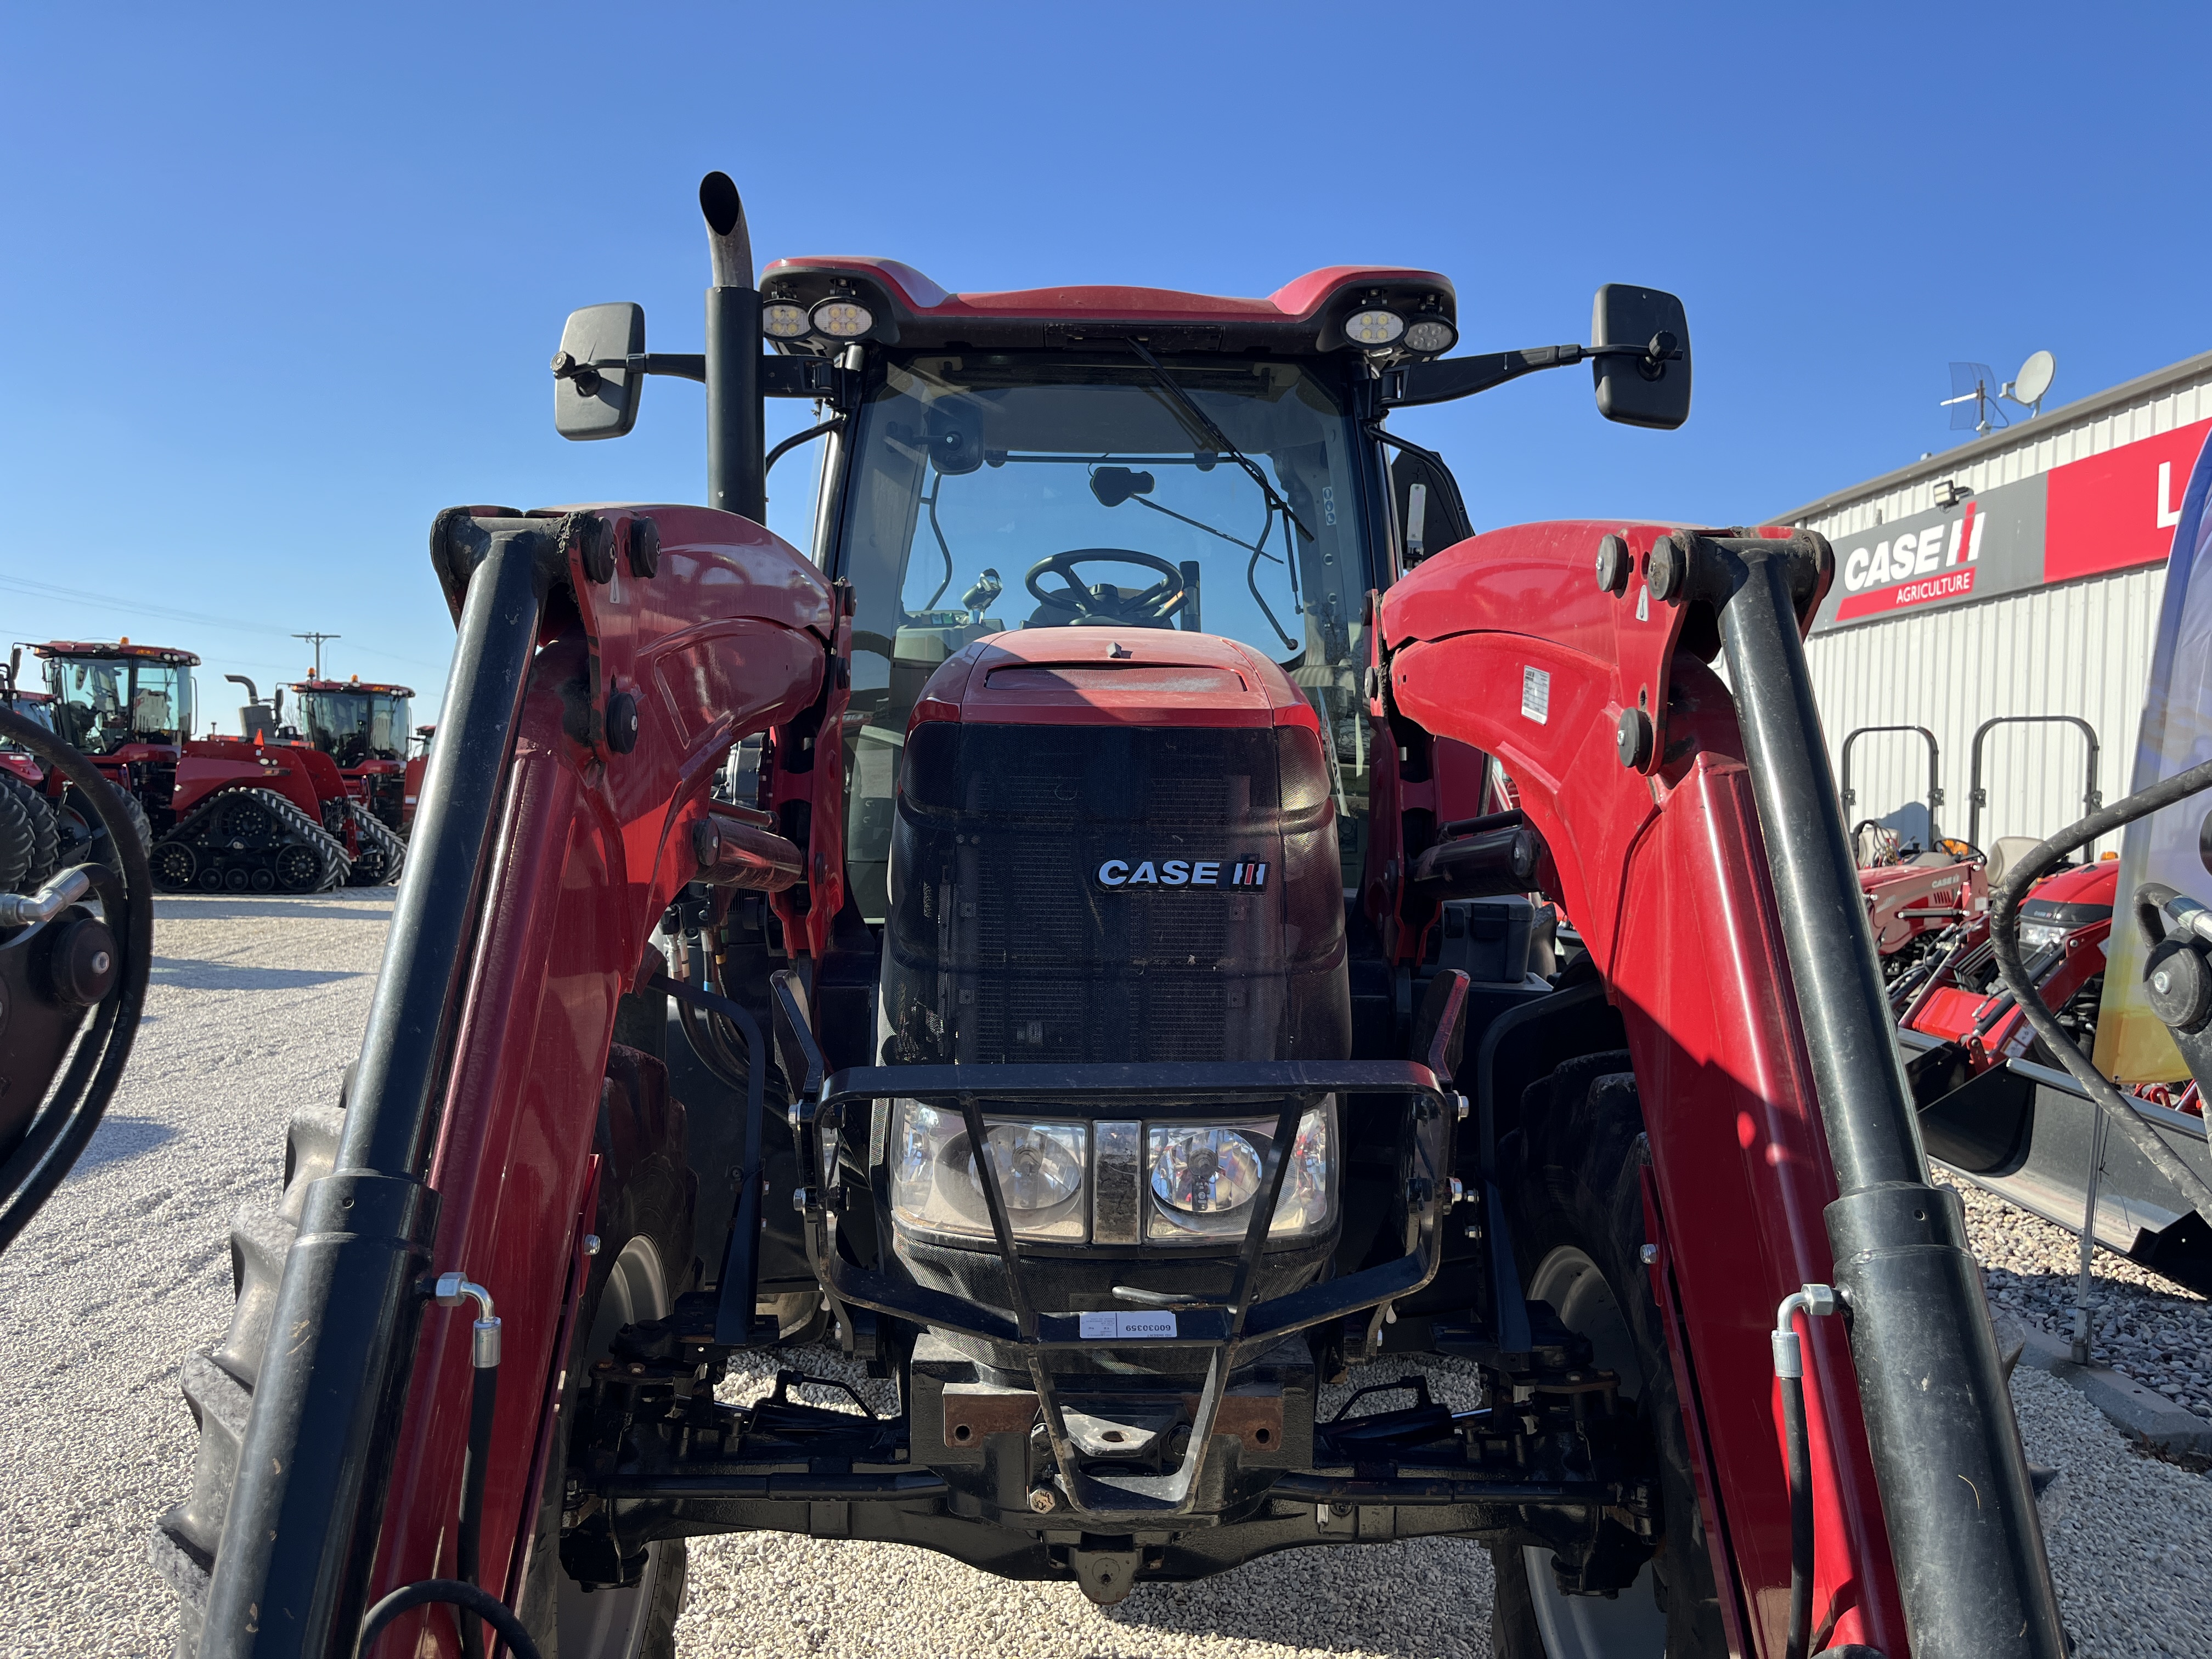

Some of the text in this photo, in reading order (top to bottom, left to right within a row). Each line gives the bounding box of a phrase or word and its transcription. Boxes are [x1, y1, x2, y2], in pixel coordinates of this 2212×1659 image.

[1844, 524, 1945, 591] CASE
[1896, 572, 1971, 604] AGRICULTURE
[1099, 860, 1220, 885] CASE
[1932, 876, 1952, 889] CASE
